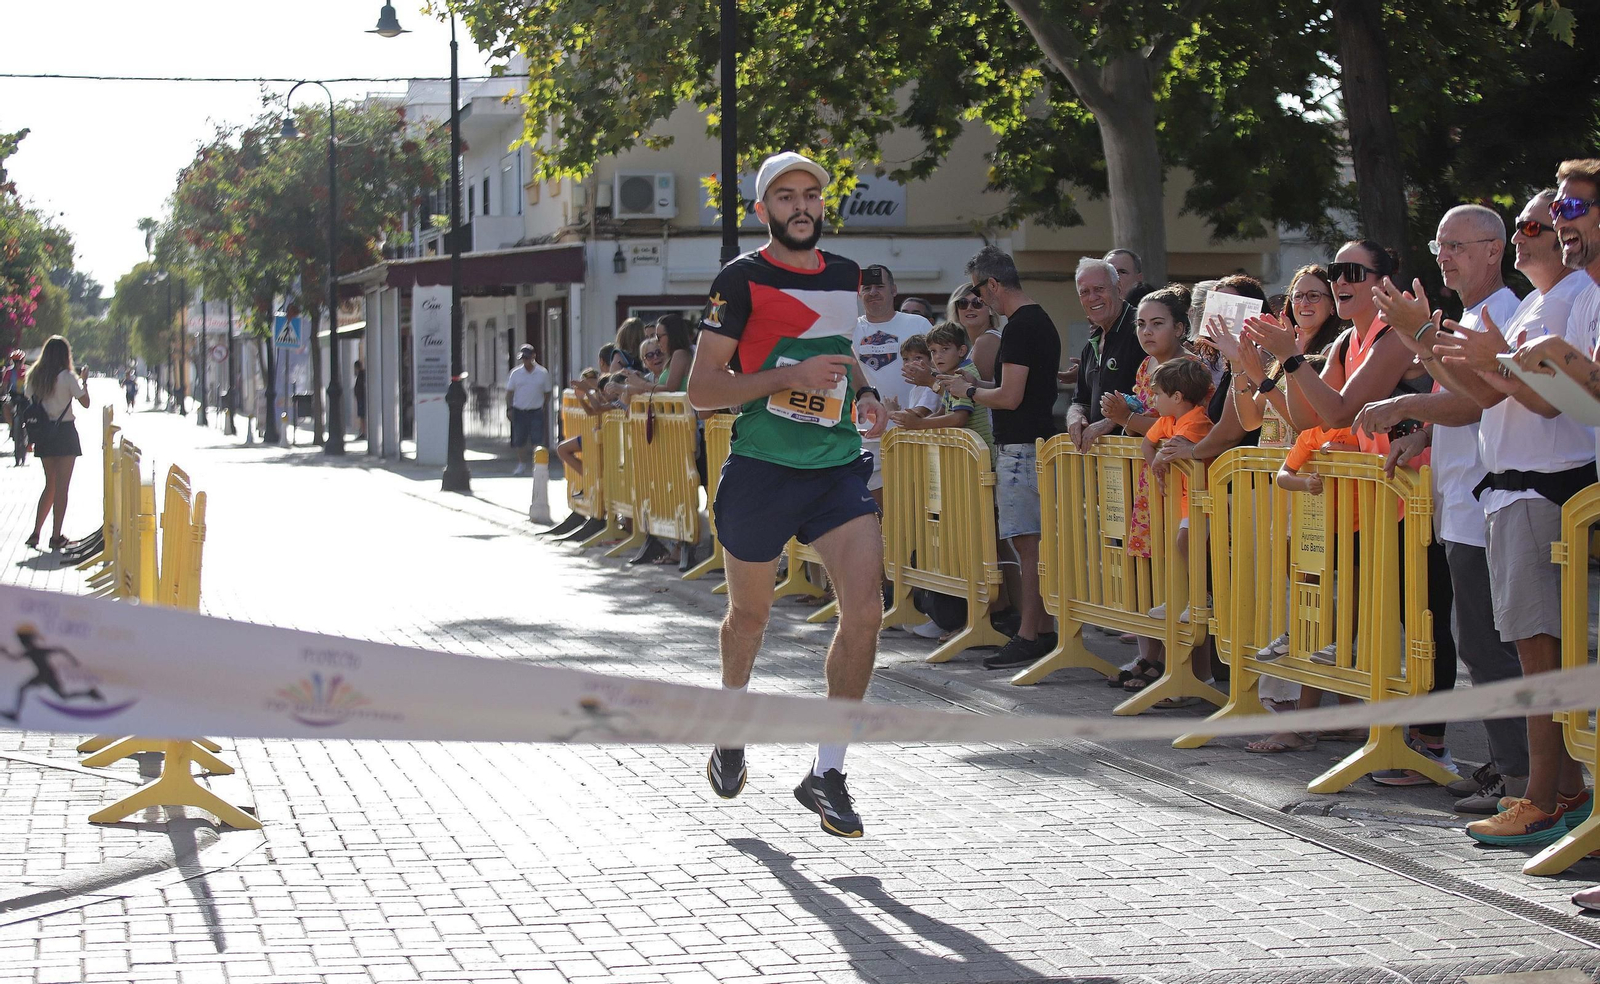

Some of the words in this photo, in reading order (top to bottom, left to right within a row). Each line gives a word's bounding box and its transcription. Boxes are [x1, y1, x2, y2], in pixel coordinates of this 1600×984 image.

[839, 183, 899, 220] Tina
[420, 333, 444, 347] Tina
[789, 391, 826, 412] 26
[1301, 541, 1309, 551] Los
[1310, 542, 1325, 553] Barrios
[1524, 817, 1555, 834] HOKA
